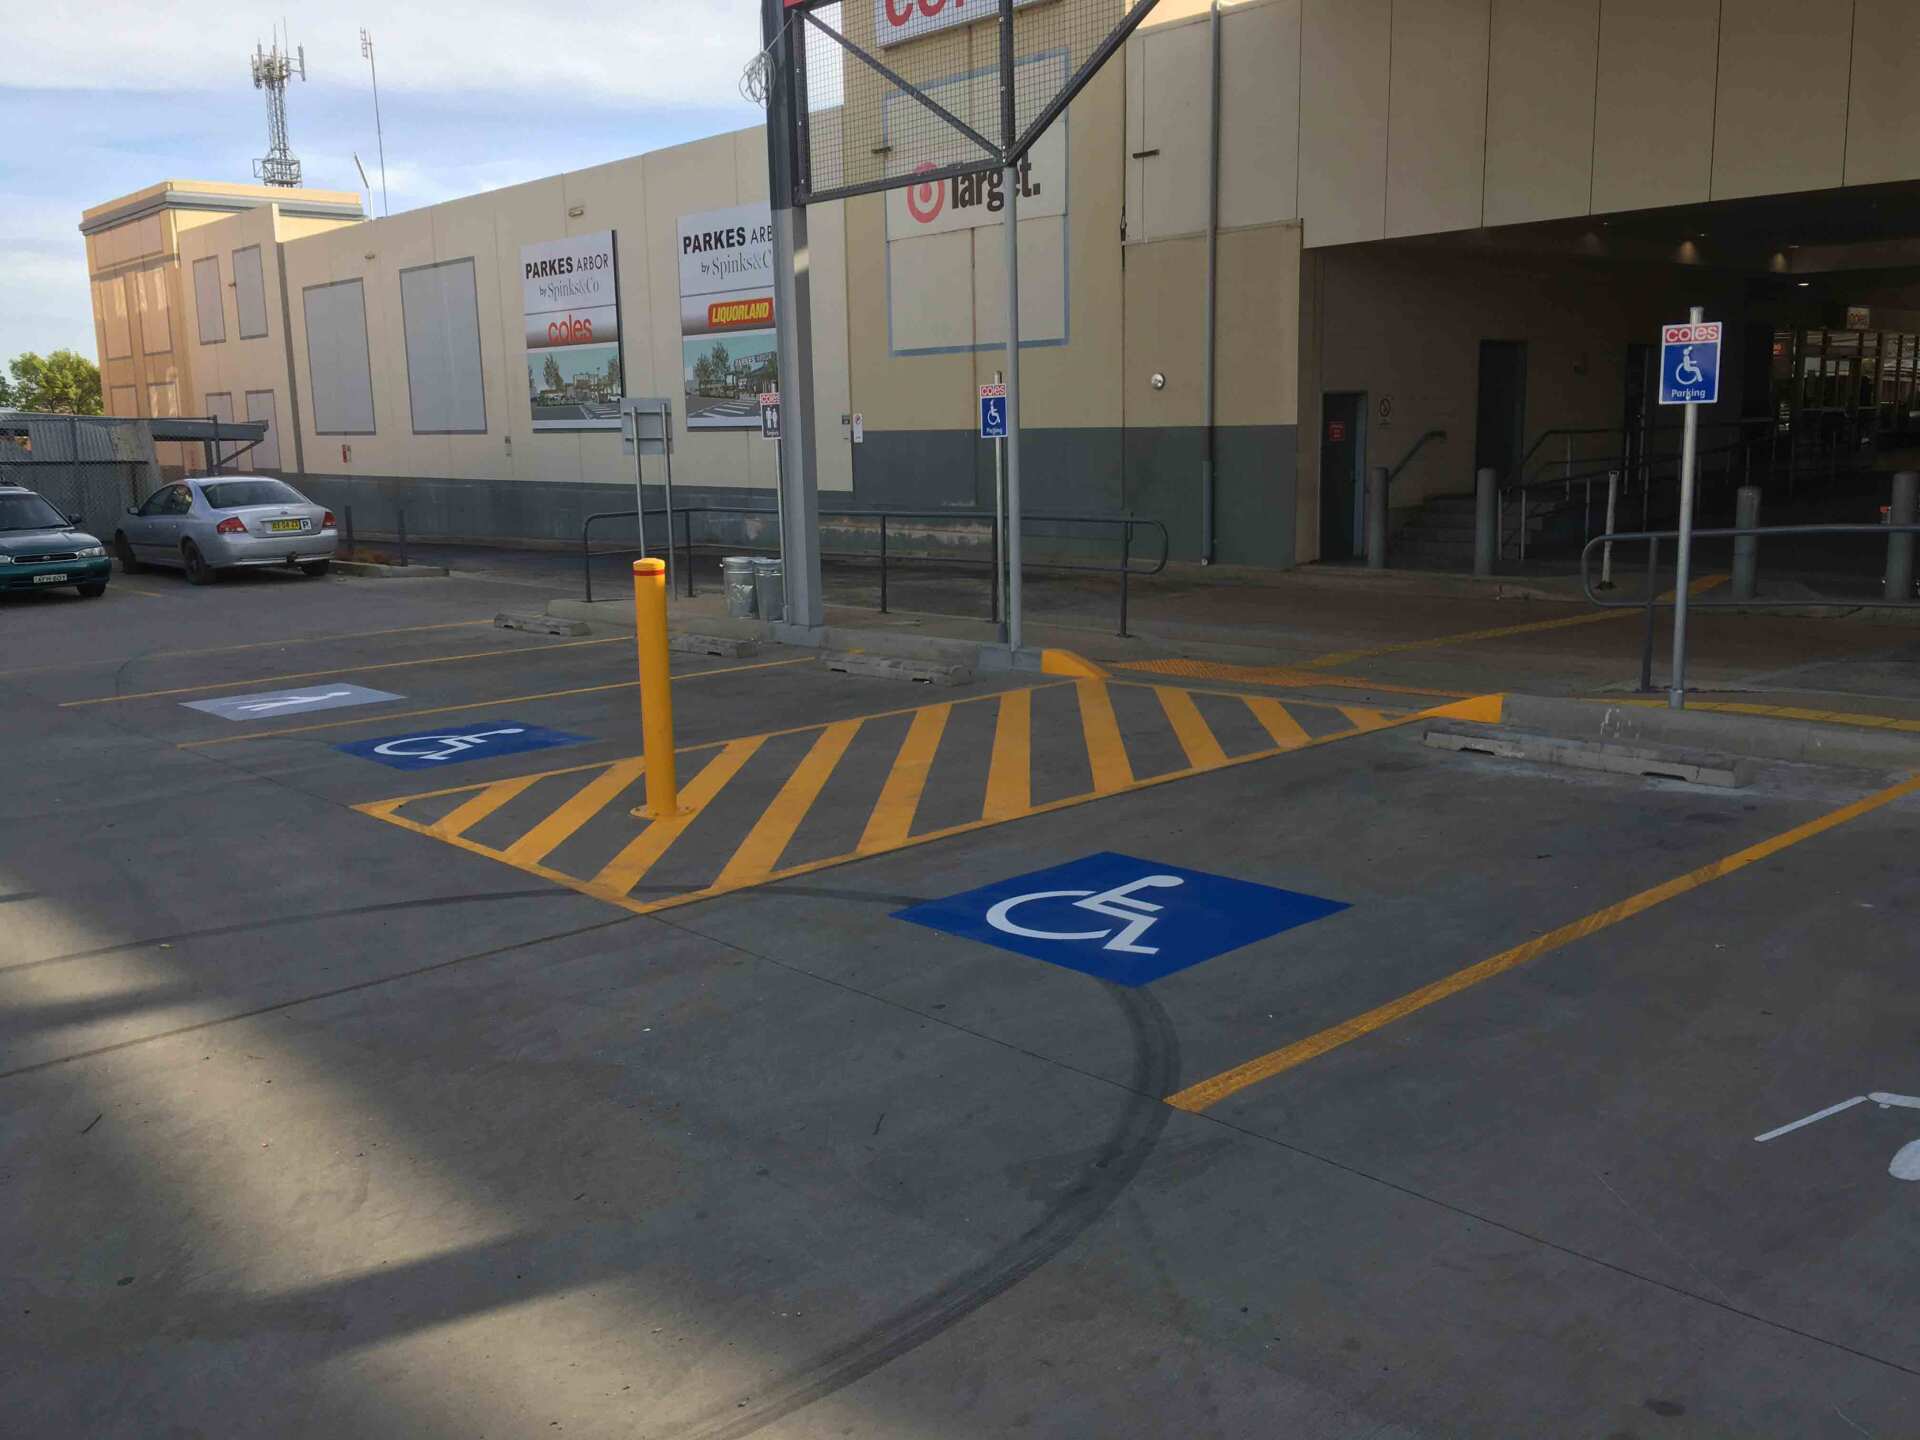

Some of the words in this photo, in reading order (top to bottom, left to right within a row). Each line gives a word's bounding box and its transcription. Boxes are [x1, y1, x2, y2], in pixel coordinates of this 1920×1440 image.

[951, 151, 1041, 213] Targt.
[683, 226, 746, 255] PARKES
[525, 255, 574, 280] PARKES
[576, 253, 609, 273] ARBOR
[701, 261, 711, 274] by
[539, 286, 548, 298] by
[547, 277, 600, 302] Spinks&Co
[711, 302, 769, 324] LIQUORLAND
[547, 314, 592, 345] coles
[1666, 325, 1718, 342] coles
[1671, 387, 1706, 399] Parking
